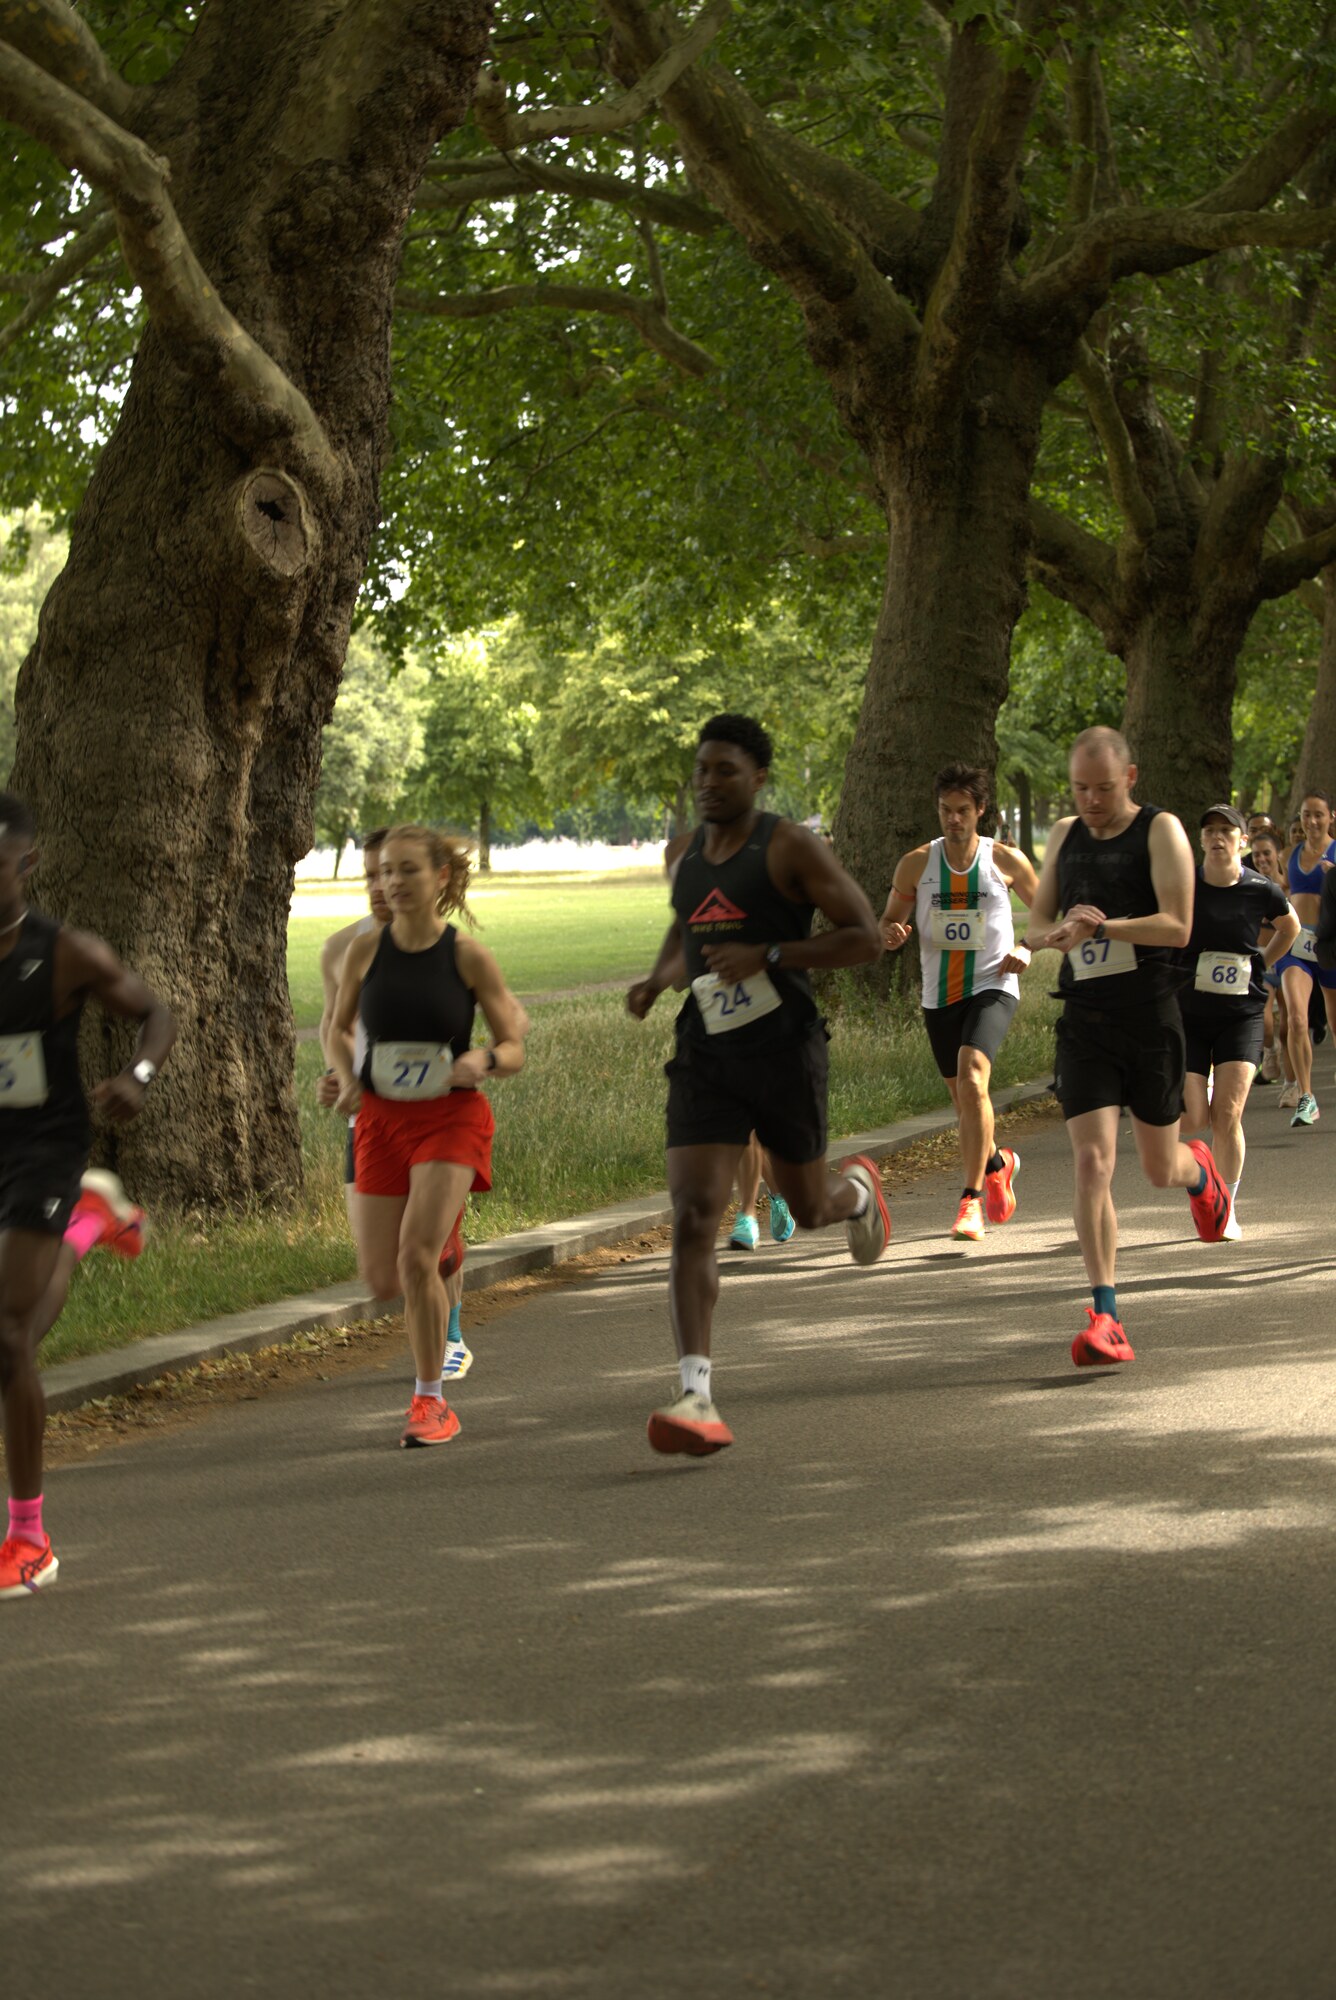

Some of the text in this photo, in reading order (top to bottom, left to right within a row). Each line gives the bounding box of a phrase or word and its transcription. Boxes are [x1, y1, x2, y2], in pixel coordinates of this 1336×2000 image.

[945, 922, 970, 941] 60
[1081, 938, 1111, 965] 67
[1212, 965, 1238, 985] 68
[713, 982, 752, 1017] 24
[393, 1060, 431, 1089] 27
